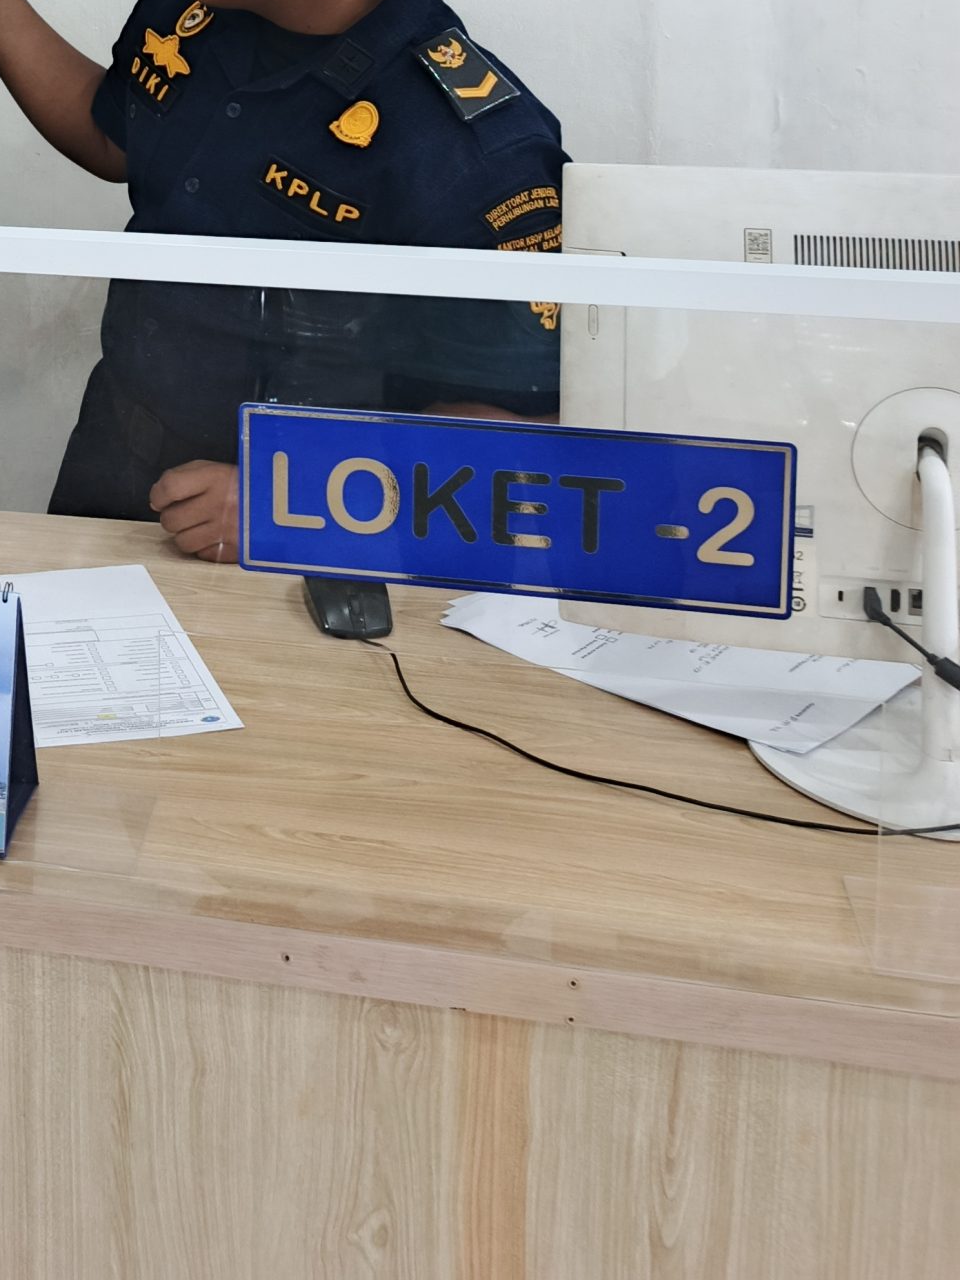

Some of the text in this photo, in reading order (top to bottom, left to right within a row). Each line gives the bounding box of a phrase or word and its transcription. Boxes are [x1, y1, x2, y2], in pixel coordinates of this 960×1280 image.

[131, 56, 169, 101] DIKI
[265, 163, 361, 222] KPLP
[484, 190, 530, 223] DIREKTORAT
[491, 200, 545, 232] PERHUBUNGAN
[272, 450, 626, 555] LOKET
